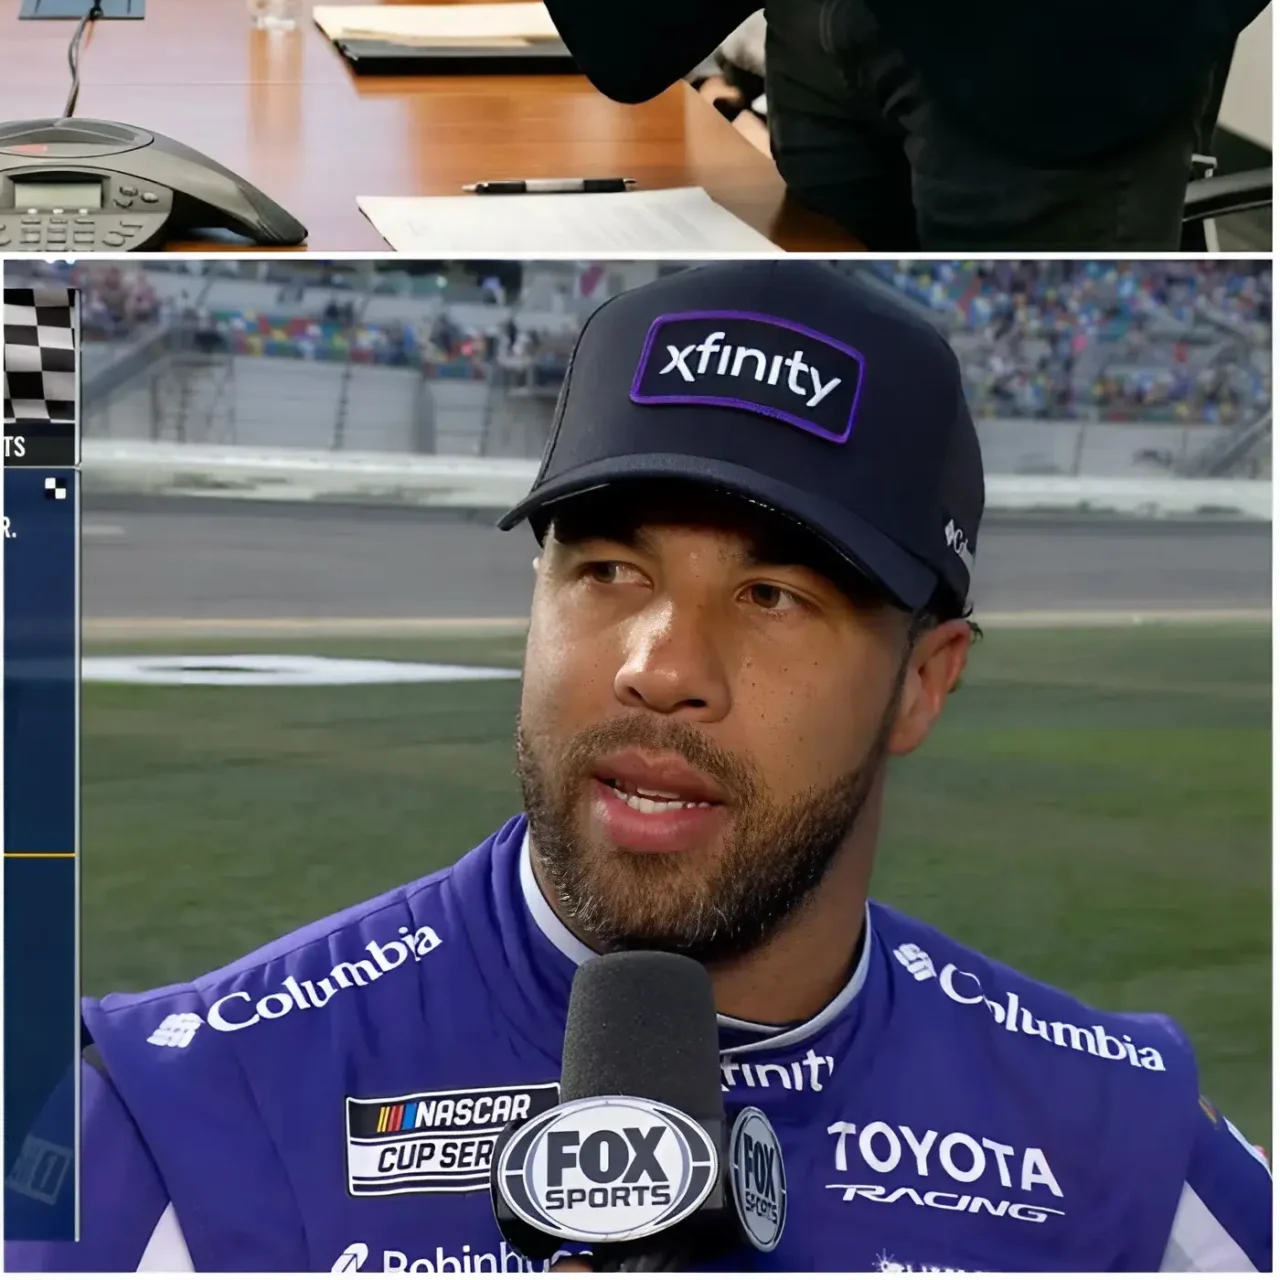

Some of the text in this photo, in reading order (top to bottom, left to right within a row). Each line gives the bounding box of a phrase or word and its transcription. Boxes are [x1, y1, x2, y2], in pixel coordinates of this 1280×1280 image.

[659, 332, 842, 408] xfinity
[206, 924, 443, 1032] Columbia
[939, 963, 1167, 1072] Columbia
[721, 1049, 835, 1093] finit
[415, 1093, 531, 1127] NASCAR
[378, 1140, 493, 1173] CUP SER
[546, 1125, 670, 1188] FOX
[743, 1132, 777, 1203] FOX
[826, 1120, 1065, 1198] TOYOTA
[545, 1185, 671, 1211] SPORTS
[825, 1184, 1066, 1224] RACING
